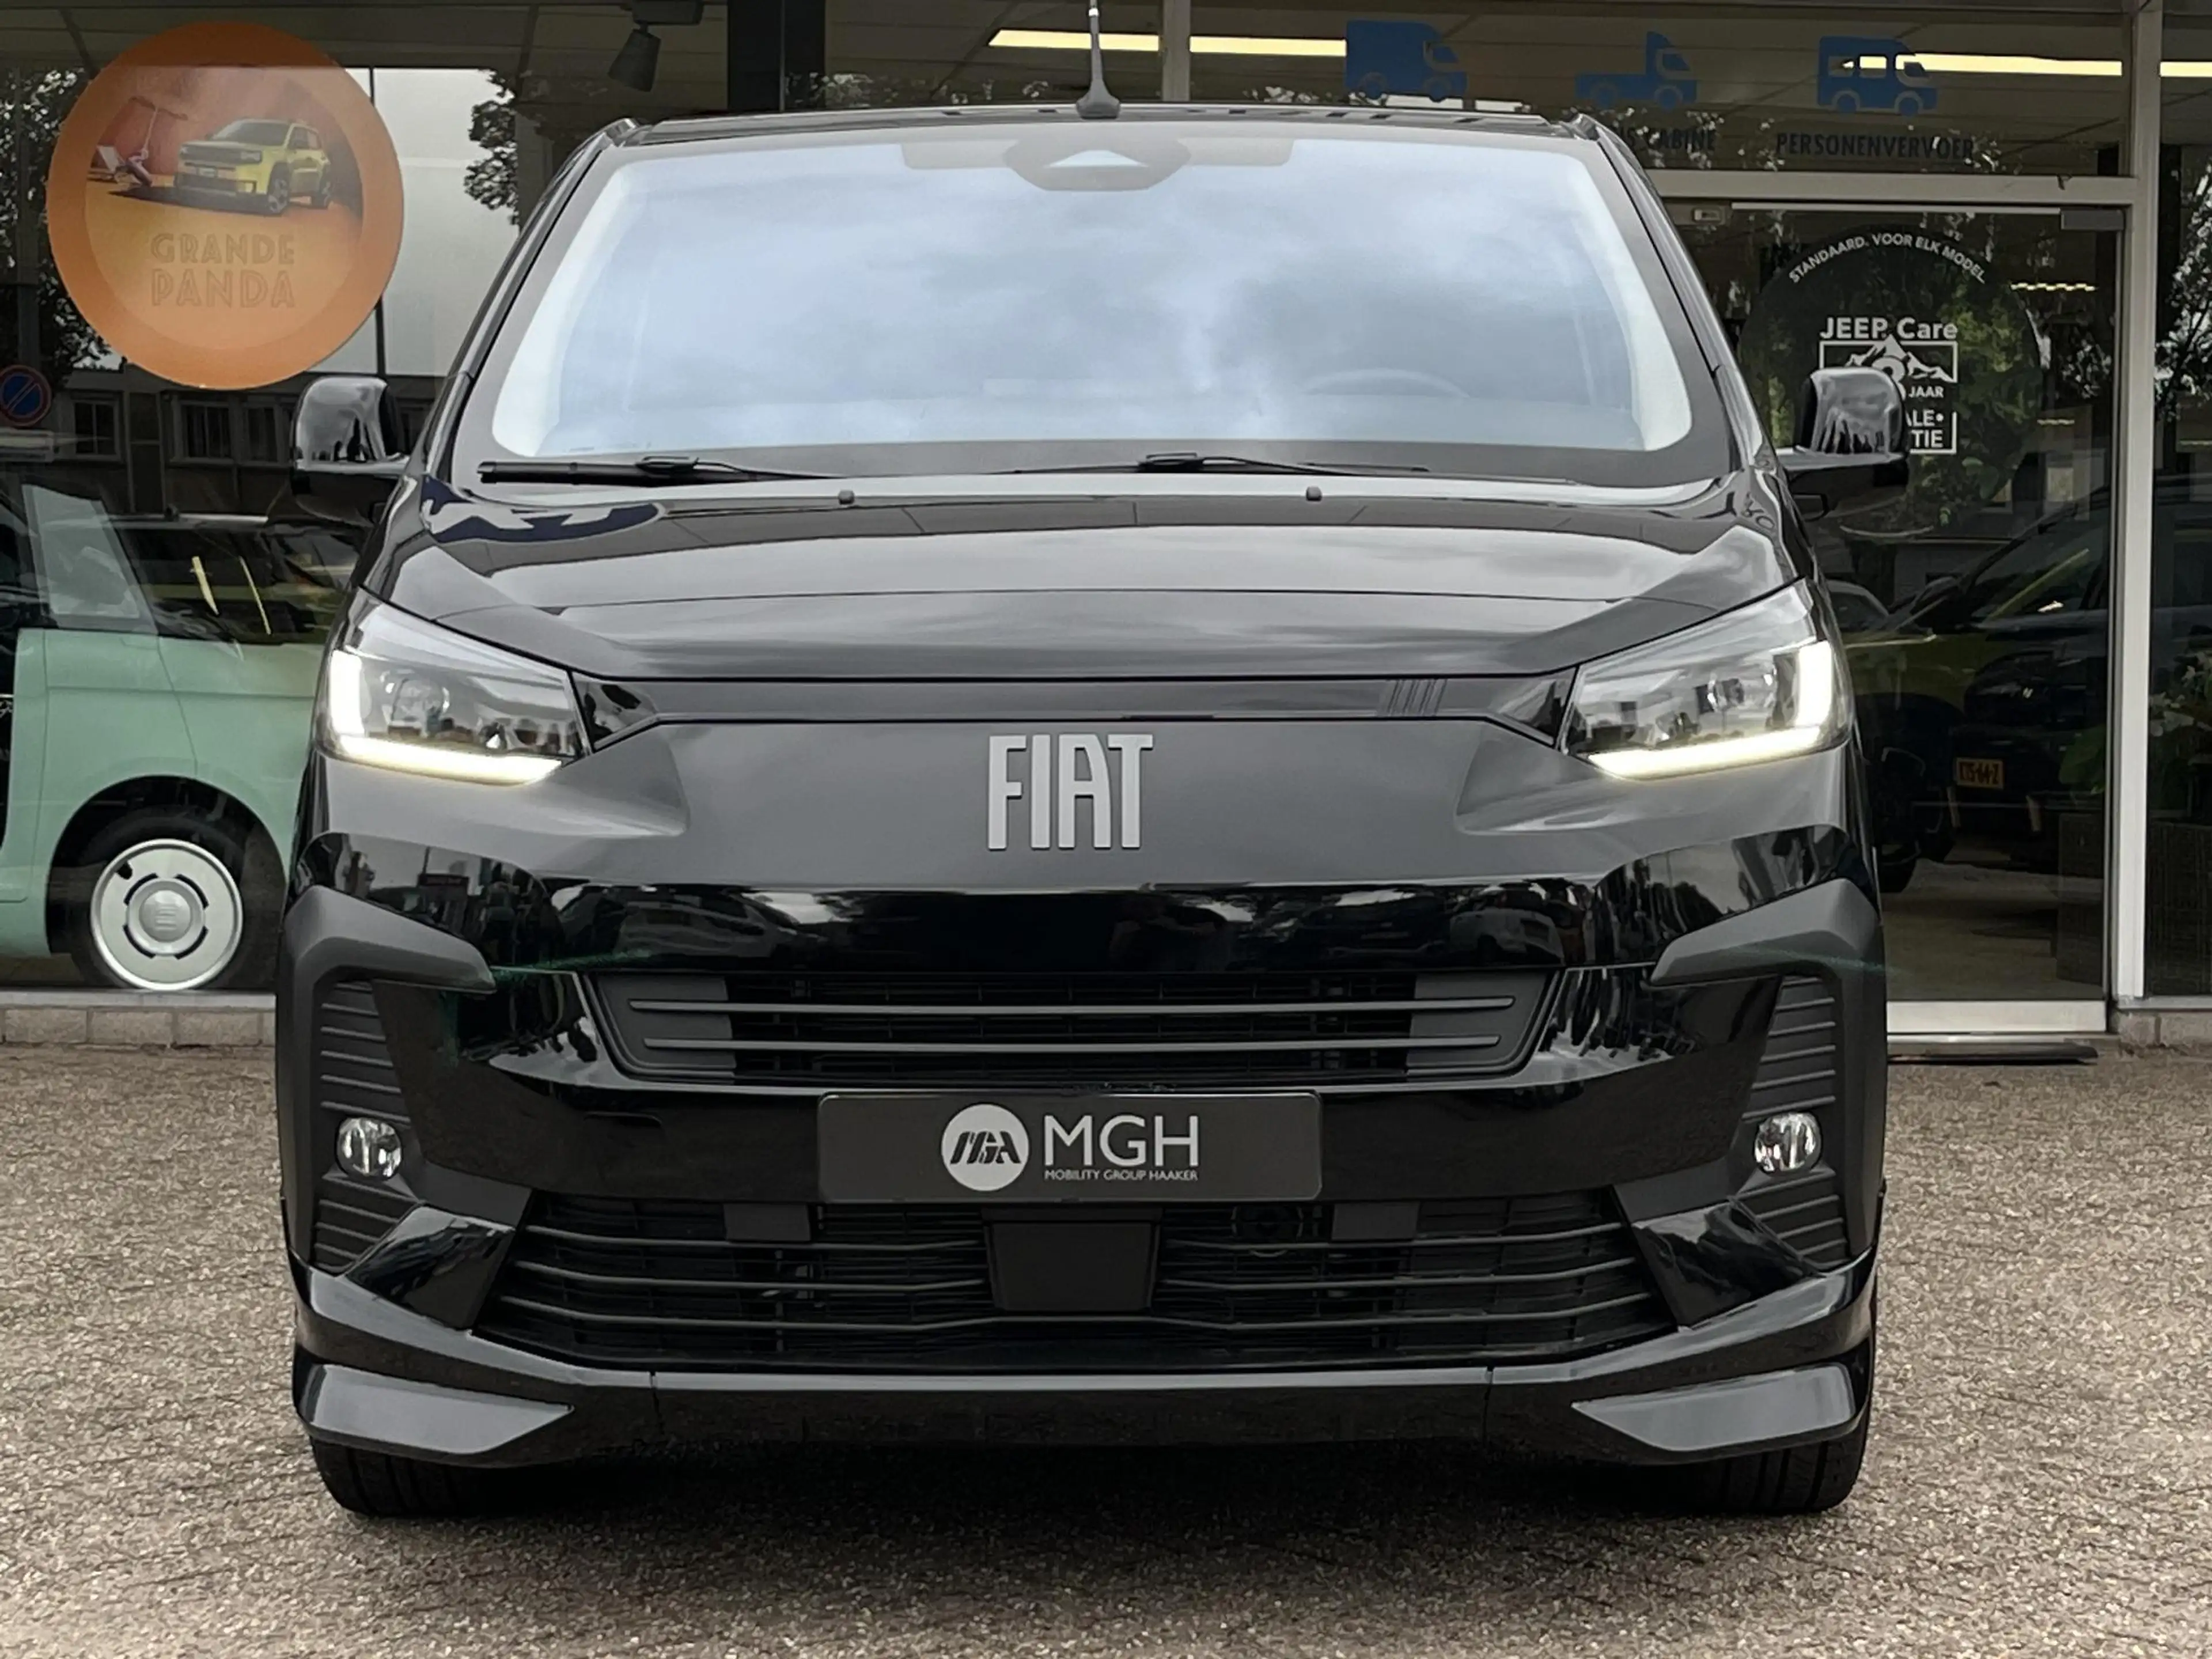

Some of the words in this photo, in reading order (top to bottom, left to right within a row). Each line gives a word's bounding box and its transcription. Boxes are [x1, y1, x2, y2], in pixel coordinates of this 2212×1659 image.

[1776, 132, 1974, 160] PERSONENVERVOER
[150, 233, 295, 264] GRANDE
[1872, 232, 1913, 246] VOOR
[1915, 236, 1941, 254] ELK
[1941, 244, 1986, 284] MODEL
[151, 268, 296, 308] PANDA
[1896, 317, 1959, 339] Care
[1908, 385, 1944, 399] JAAR
[988, 734, 1153, 851] FIAT
[1044, 1113, 1199, 1167] MGH
[1044, 1169, 1100, 1180] MOBILITY
[1103, 1169, 1146, 1181] GROUP
[1149, 1170, 1199, 1181] HAAKER
